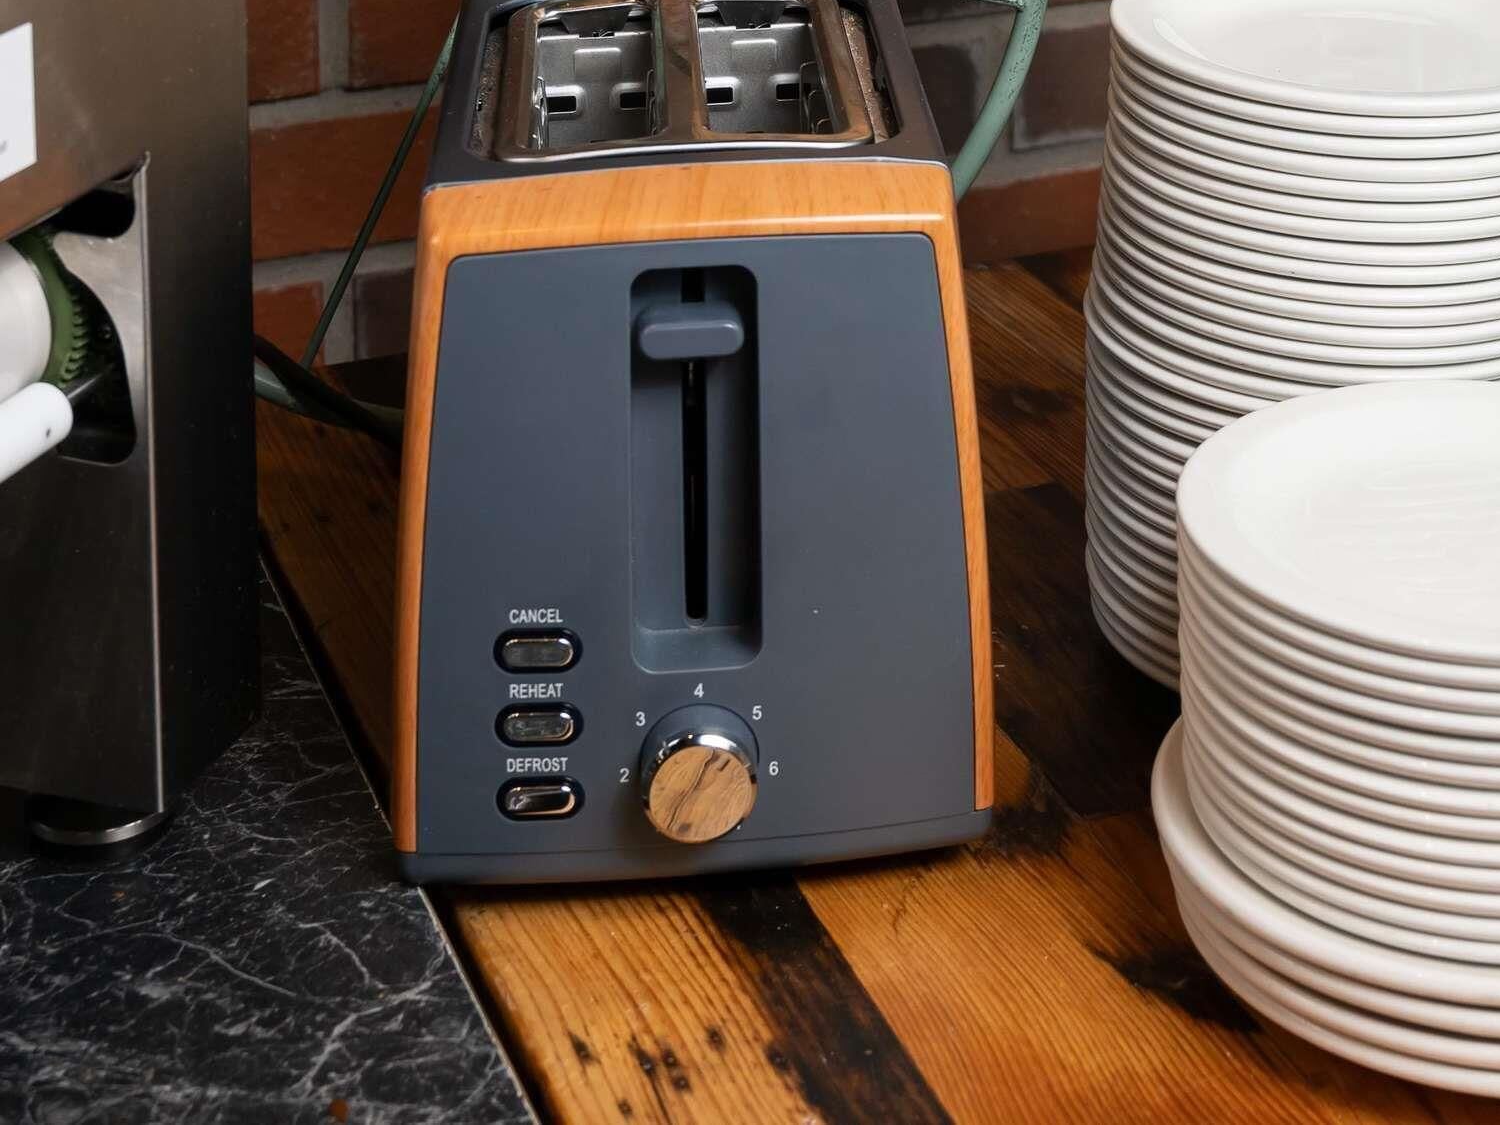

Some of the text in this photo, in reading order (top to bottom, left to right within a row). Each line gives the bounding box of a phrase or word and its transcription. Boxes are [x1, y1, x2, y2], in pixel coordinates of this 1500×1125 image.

[509, 608, 564, 624] CANCEL
[509, 683, 564, 699] REHEAT
[693, 684, 704, 698] 4
[635, 712, 646, 727] 3
[752, 705, 763, 721] 5
[506, 757, 569, 773] DEFROST
[769, 761, 779, 776] 6
[619, 768, 630, 783] 2
